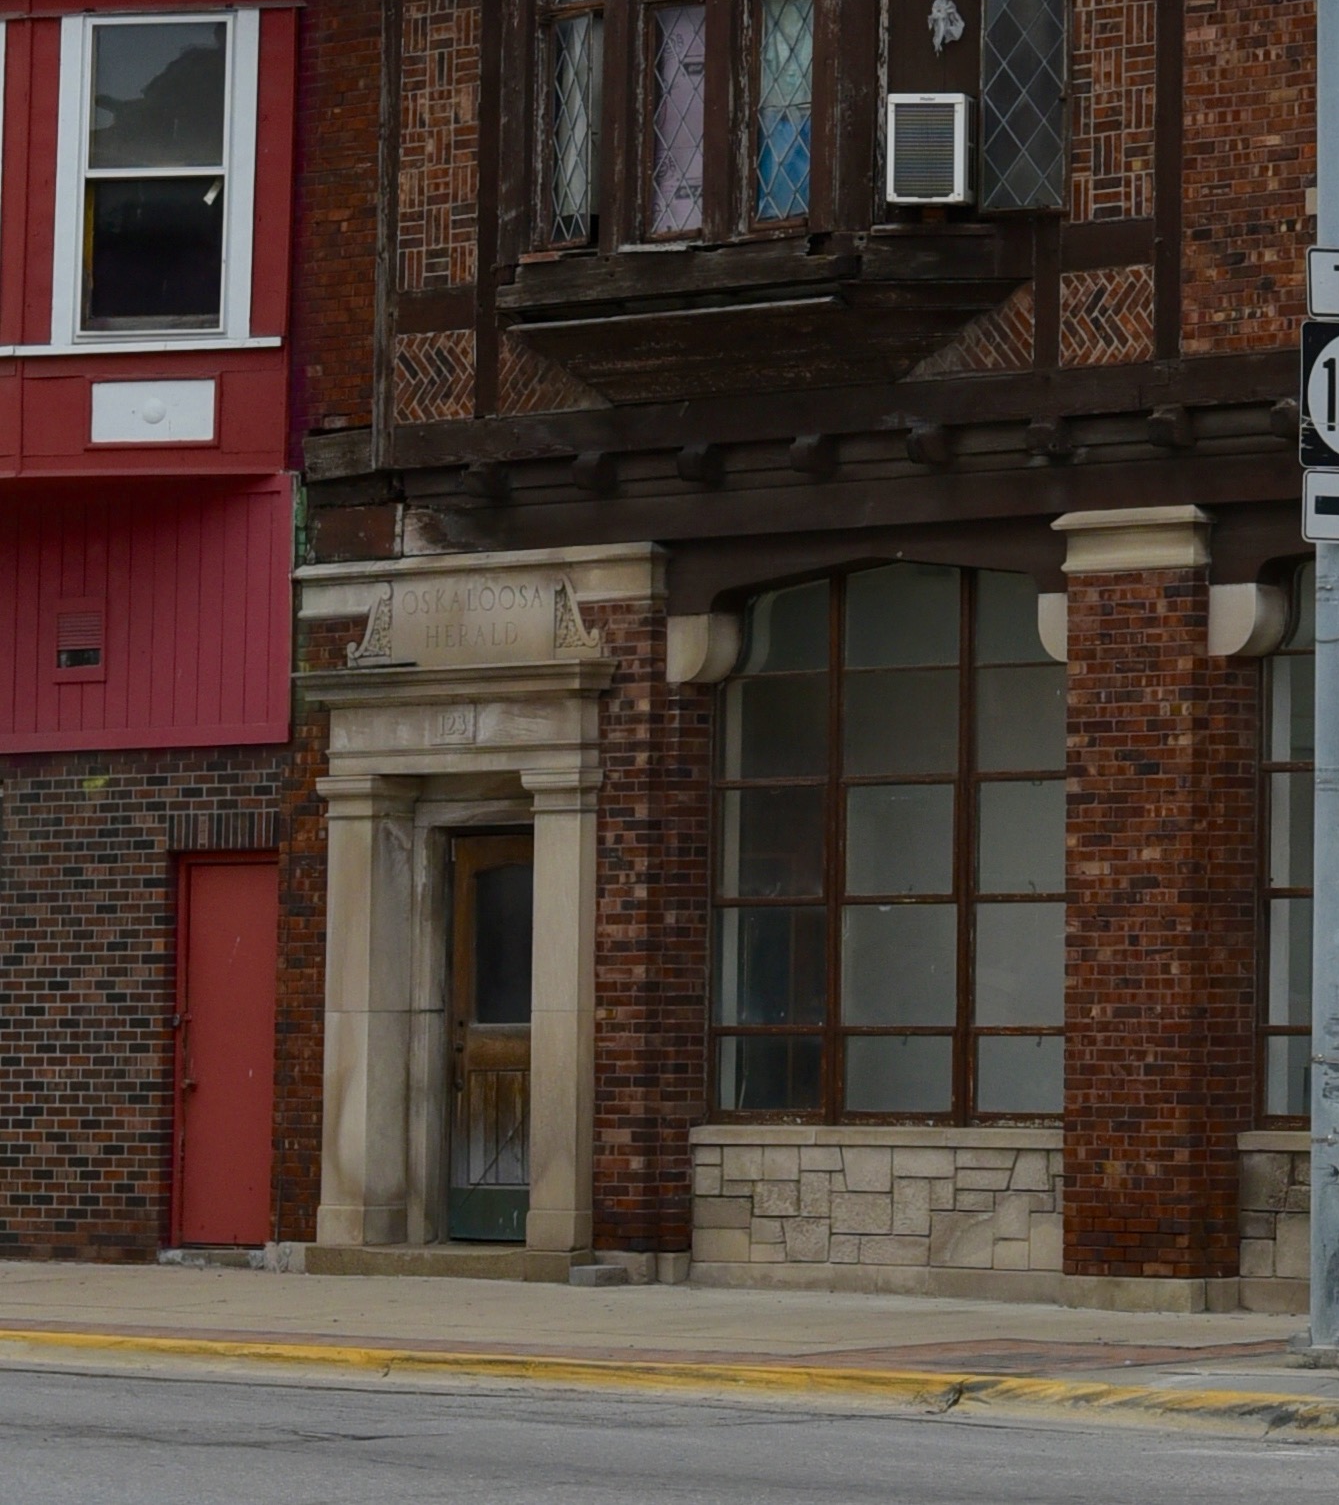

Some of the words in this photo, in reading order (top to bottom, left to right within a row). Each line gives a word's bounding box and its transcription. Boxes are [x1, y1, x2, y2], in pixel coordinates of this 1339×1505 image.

[402, 584, 543, 615] OSKALOOSA
[425, 621, 518, 648] HERALD
[439, 713, 468, 737] 123
